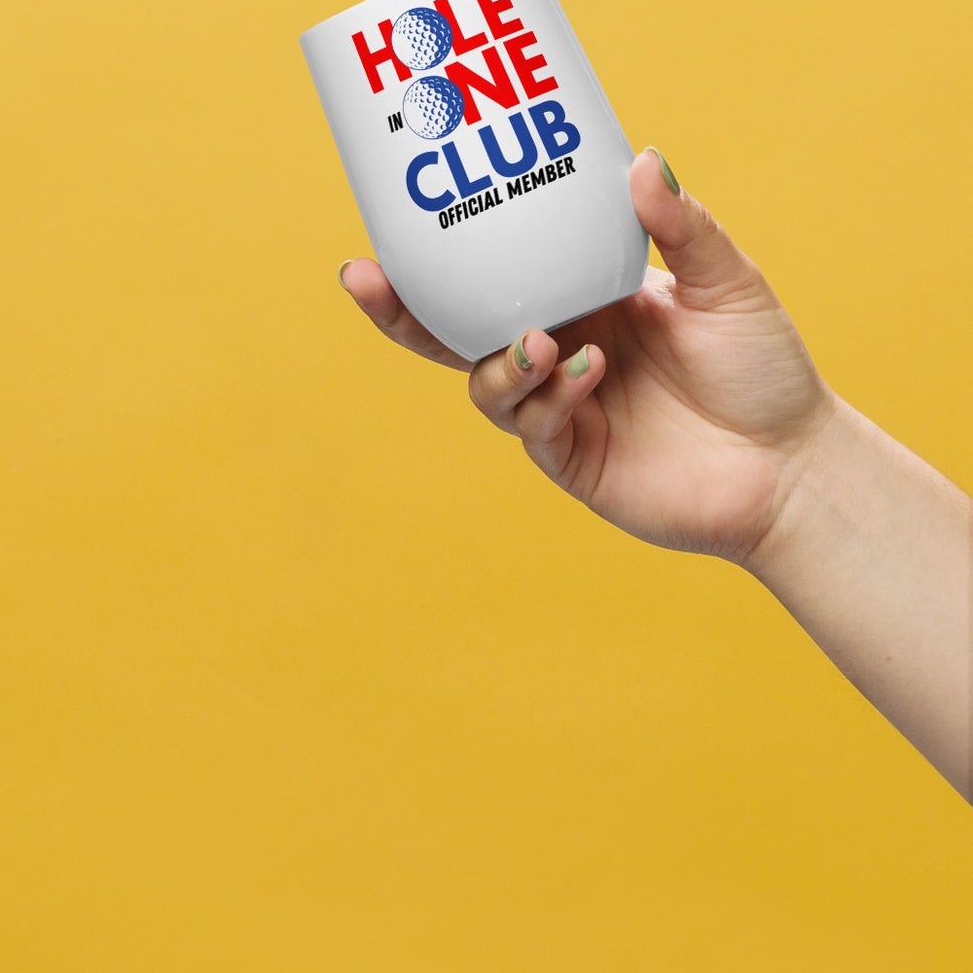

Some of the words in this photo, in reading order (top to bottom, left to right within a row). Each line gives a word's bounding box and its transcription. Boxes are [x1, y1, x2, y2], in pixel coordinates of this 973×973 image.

[388, 112, 404, 133] IN
[405, 100, 581, 212] CLUB
[438, 187, 504, 230] OFFICIAL
[506, 156, 576, 200] MEMBER
